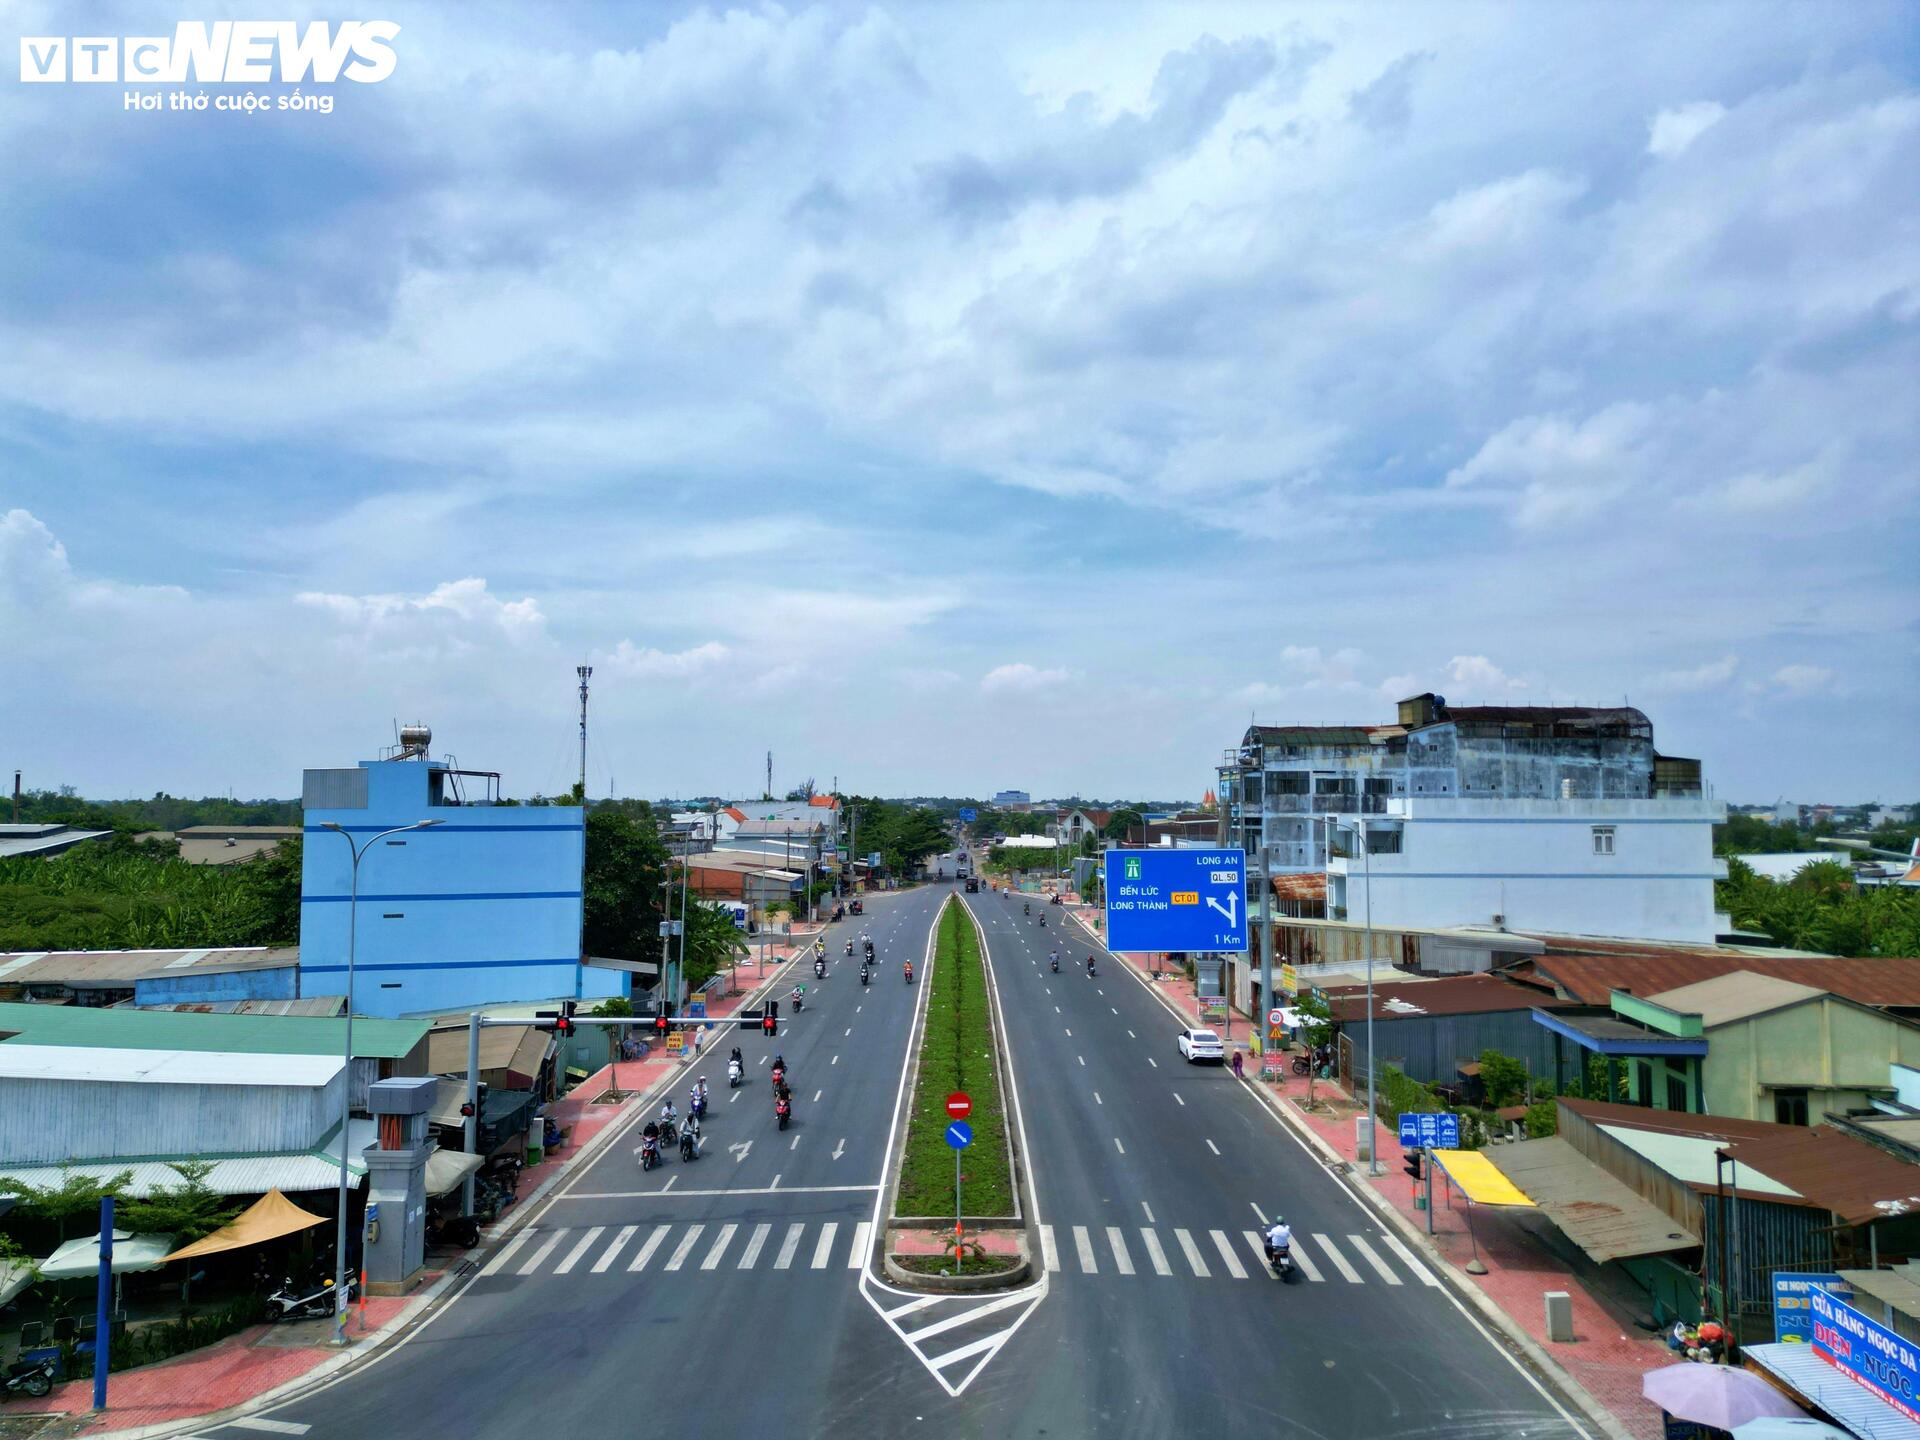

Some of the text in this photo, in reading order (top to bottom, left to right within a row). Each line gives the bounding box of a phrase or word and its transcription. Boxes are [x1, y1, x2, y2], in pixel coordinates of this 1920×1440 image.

[1196, 856, 1238, 865] LONG AN
[1120, 884, 1159, 896] BẾN LỨC
[1110, 901, 1134, 910] LONG
[1214, 934, 1241, 944] 1 Km
[1271, 1013, 1280, 1022] 40
[1812, 1293, 1833, 1321] CỬA
[1834, 1307, 1865, 1338] HÀNG
[1867, 1326, 1898, 1359] NGỌC
[1814, 1320, 1852, 1361] ĐIỆN
[1863, 1351, 1912, 1399] NƯỚC
